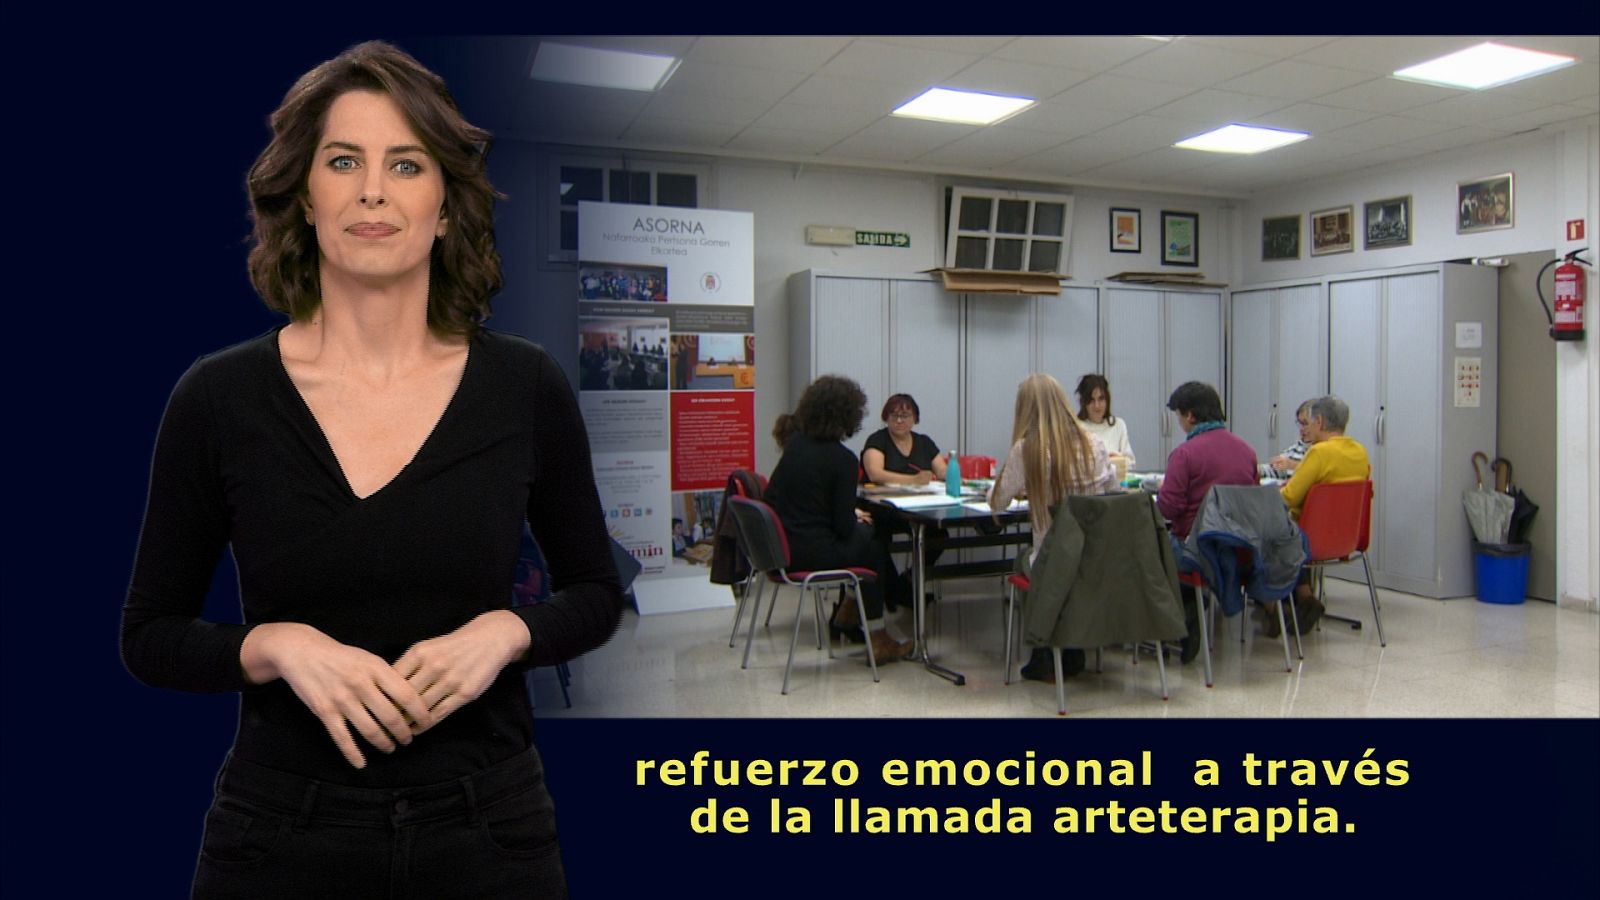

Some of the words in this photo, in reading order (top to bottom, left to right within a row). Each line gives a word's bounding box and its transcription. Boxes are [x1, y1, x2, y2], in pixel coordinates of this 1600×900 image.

[632, 217, 705, 234] ASORNA
[658, 235, 697, 246] Pertsona
[856, 232, 893, 246] SALIDA
[651, 246, 688, 256] Elkartea
